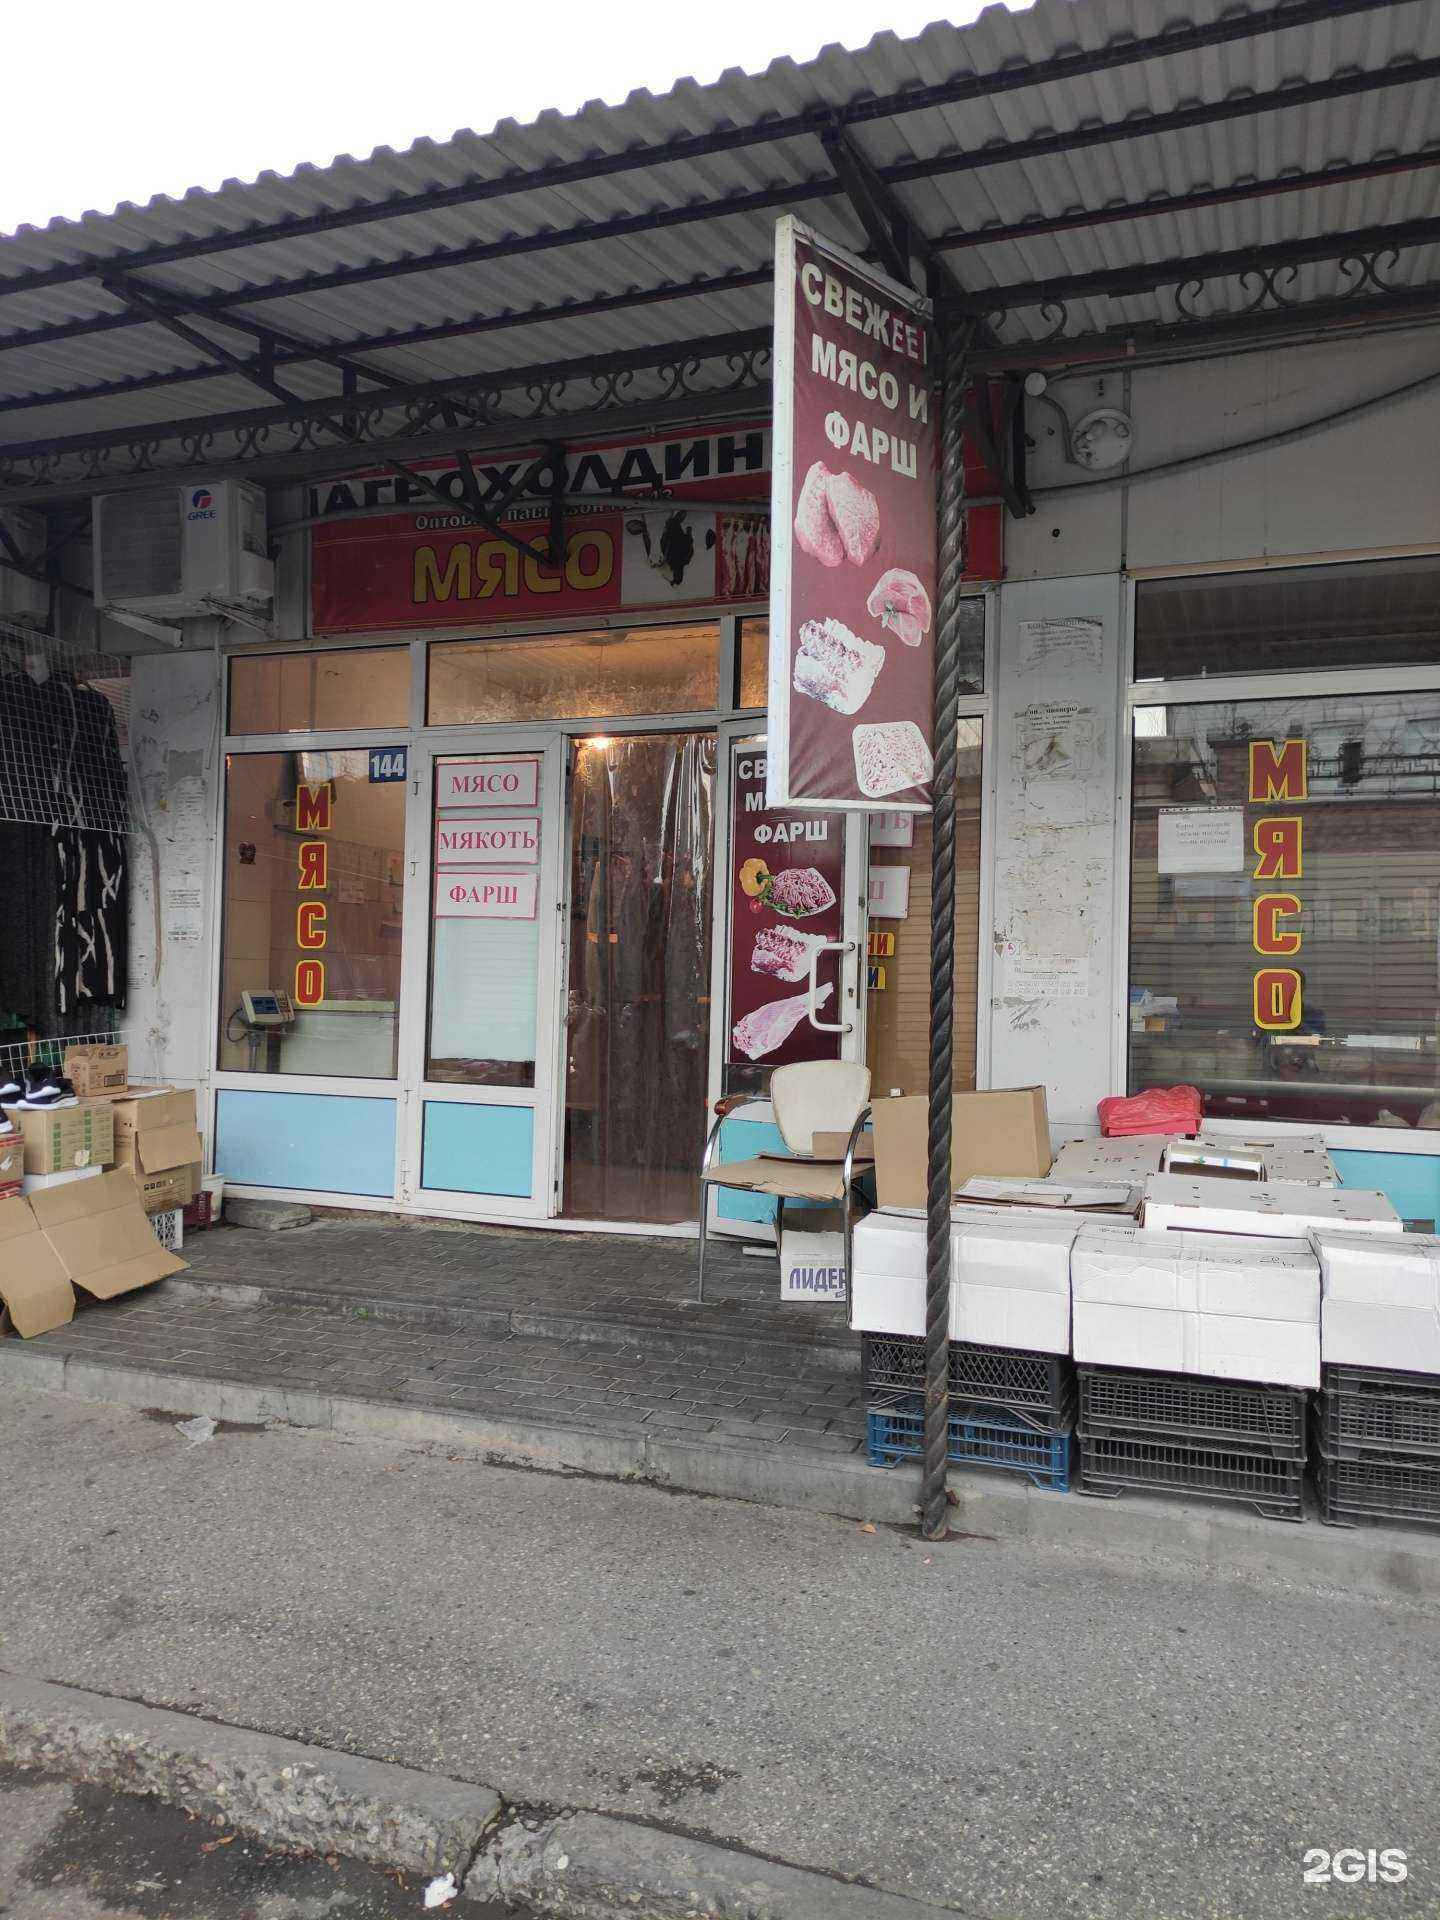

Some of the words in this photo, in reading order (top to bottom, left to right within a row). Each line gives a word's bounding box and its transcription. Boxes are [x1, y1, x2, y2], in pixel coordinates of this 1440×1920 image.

[801, 262, 919, 360] СВЕЖЕЕ
[812, 333, 899, 410] МЯСО
[909, 384, 928, 424] И
[325, 431, 764, 513] АГРОХОЛДИН
[825, 410, 917, 480] ФАРШ
[187, 509, 217, 521] GREE
[412, 529, 615, 604] МЯСО
[370, 750, 405, 779] 144
[451, 773, 519, 794] МЯСО
[440, 830, 537, 850] МЯКОТЬ
[753, 820, 828, 844] ФАРШ
[296, 782, 332, 1006] МЯСО
[449, 884, 518, 904] ФАРШ
[1249, 739, 1308, 1031] МЯСО
